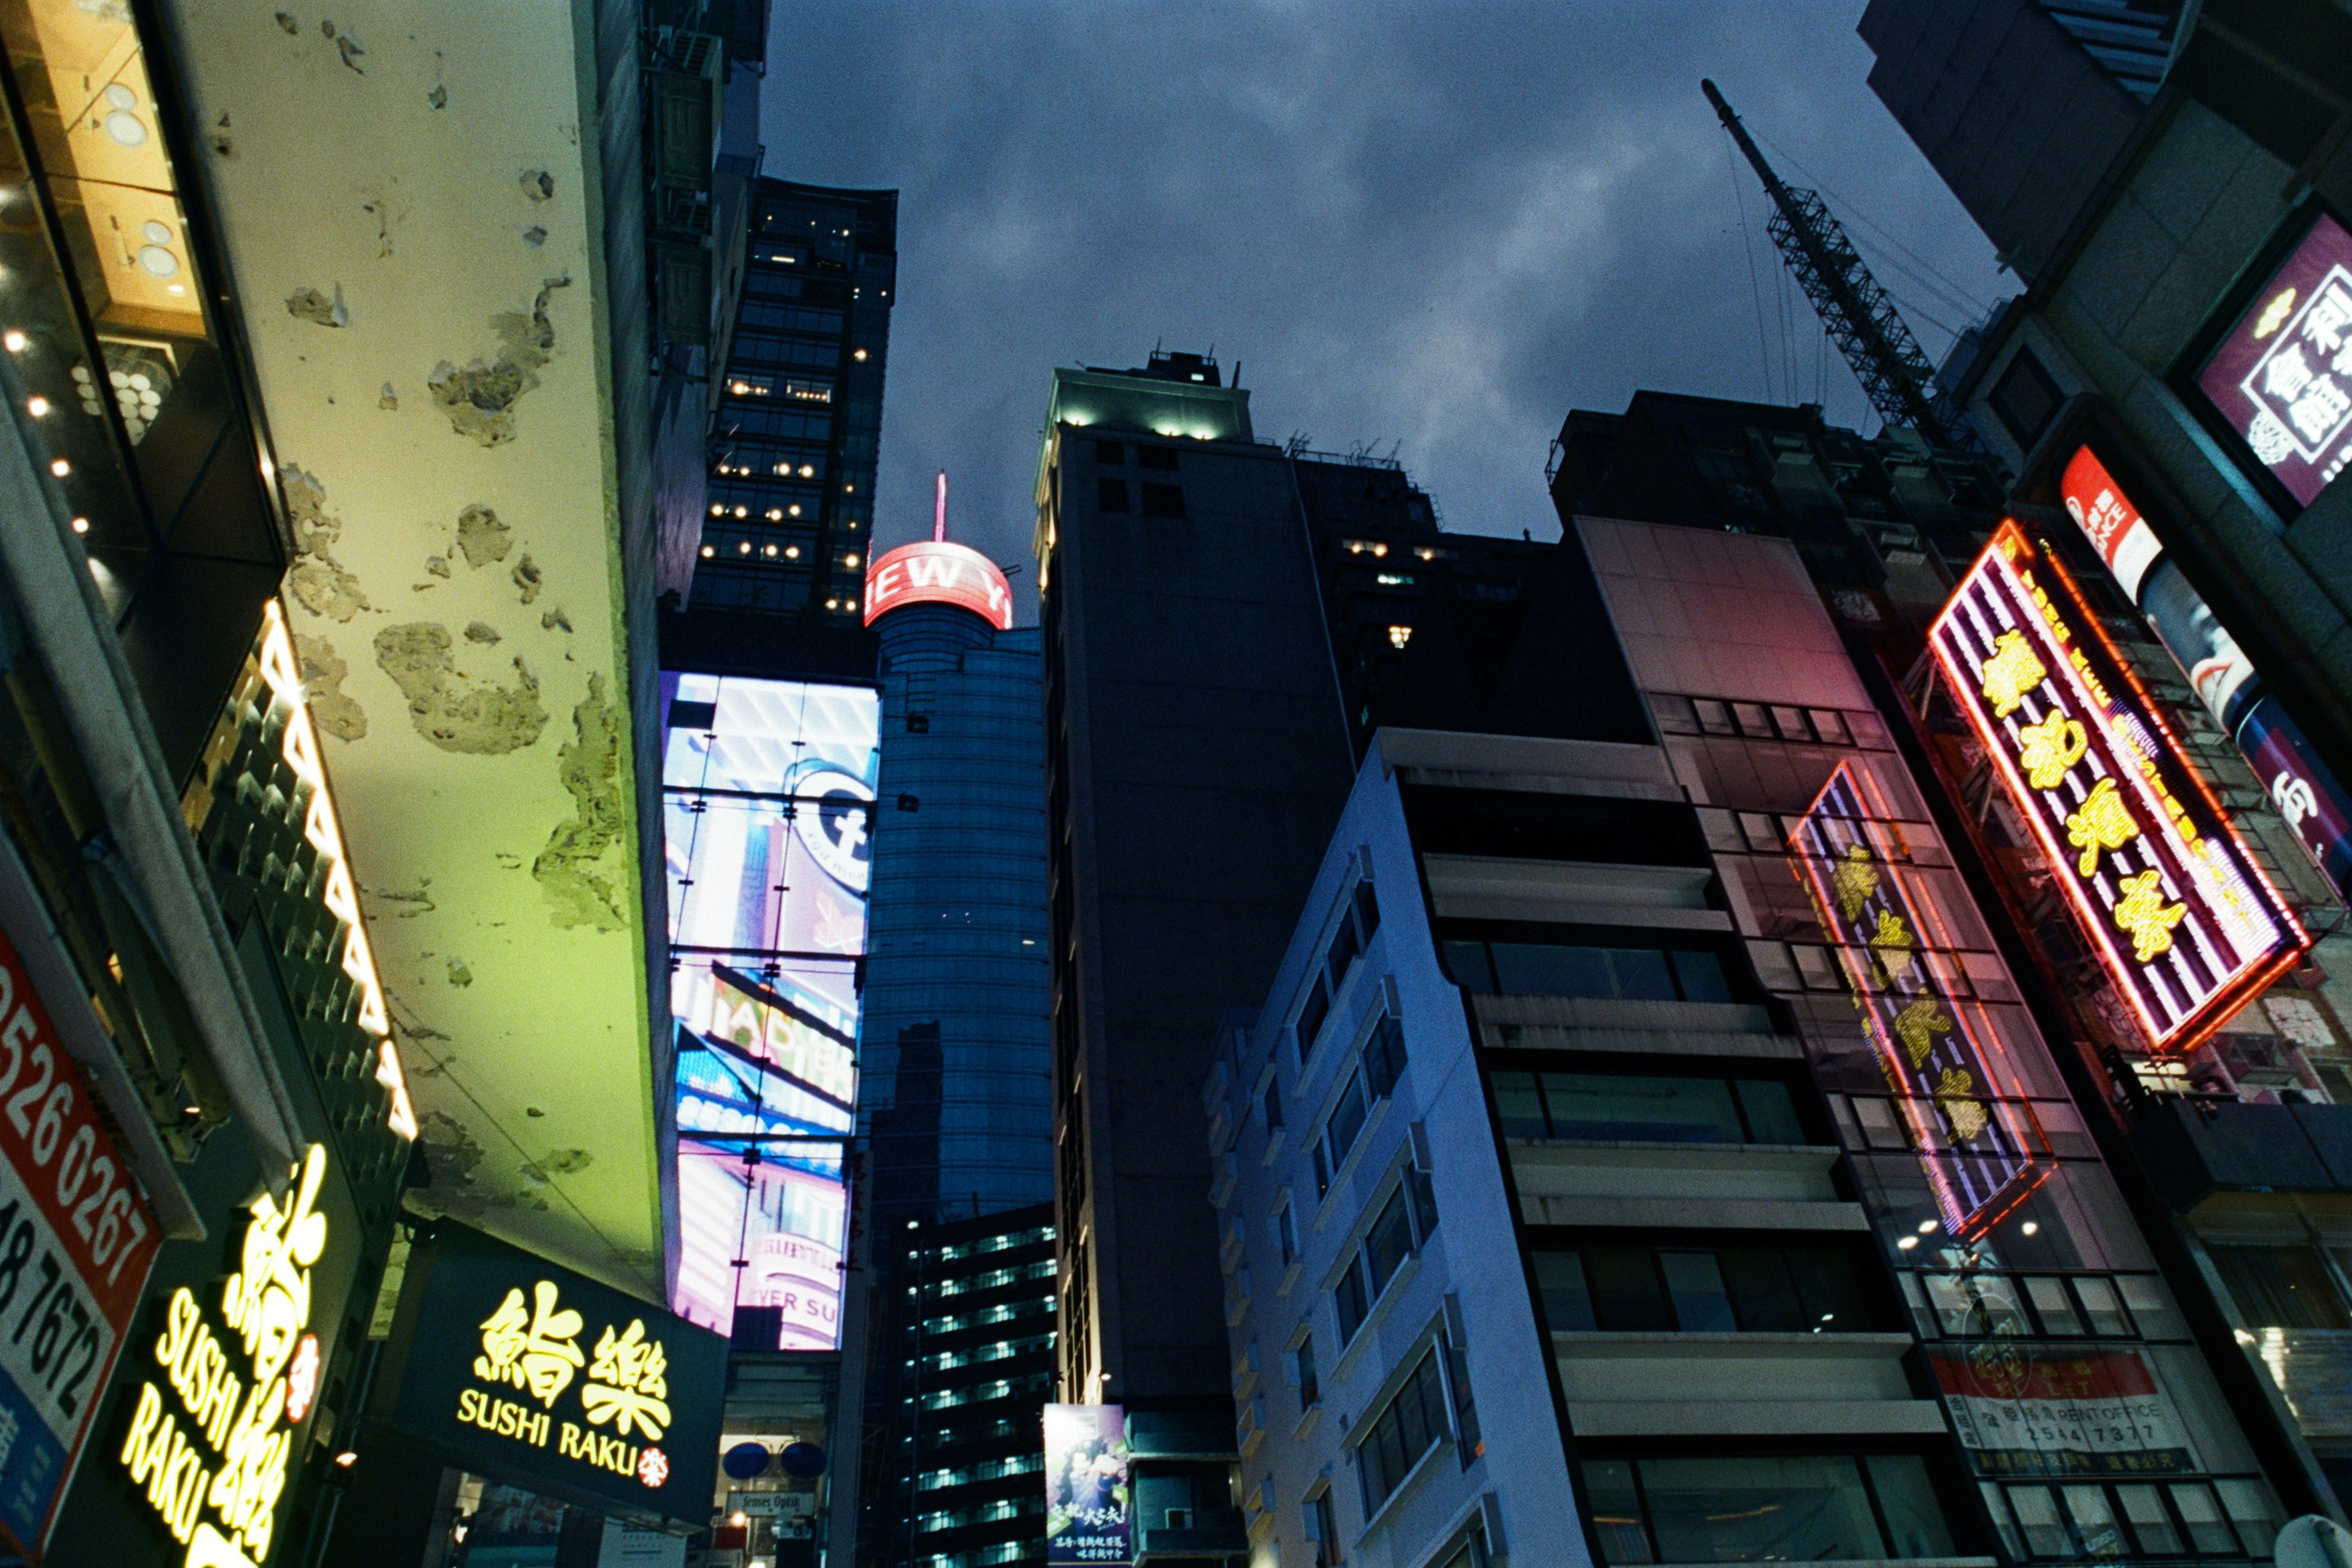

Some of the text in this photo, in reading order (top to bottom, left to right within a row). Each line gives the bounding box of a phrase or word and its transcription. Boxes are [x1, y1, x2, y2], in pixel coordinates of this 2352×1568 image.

[979, 569, 1012, 630] Y
[2021, 568, 2256, 933] YUNG KEE RESTAURANT
[0, 964, 147, 1287] 526 0267
[13, 1250, 99, 1420] 7672
[155, 1286, 242, 1452] SUSHI
[2102, 1403, 2161, 1420] OFFICE
[121, 1380, 209, 1545] RAKU
[457, 1388, 638, 1476] SUSHI RAKU
[2093, 1425, 2154, 1443] 7377
